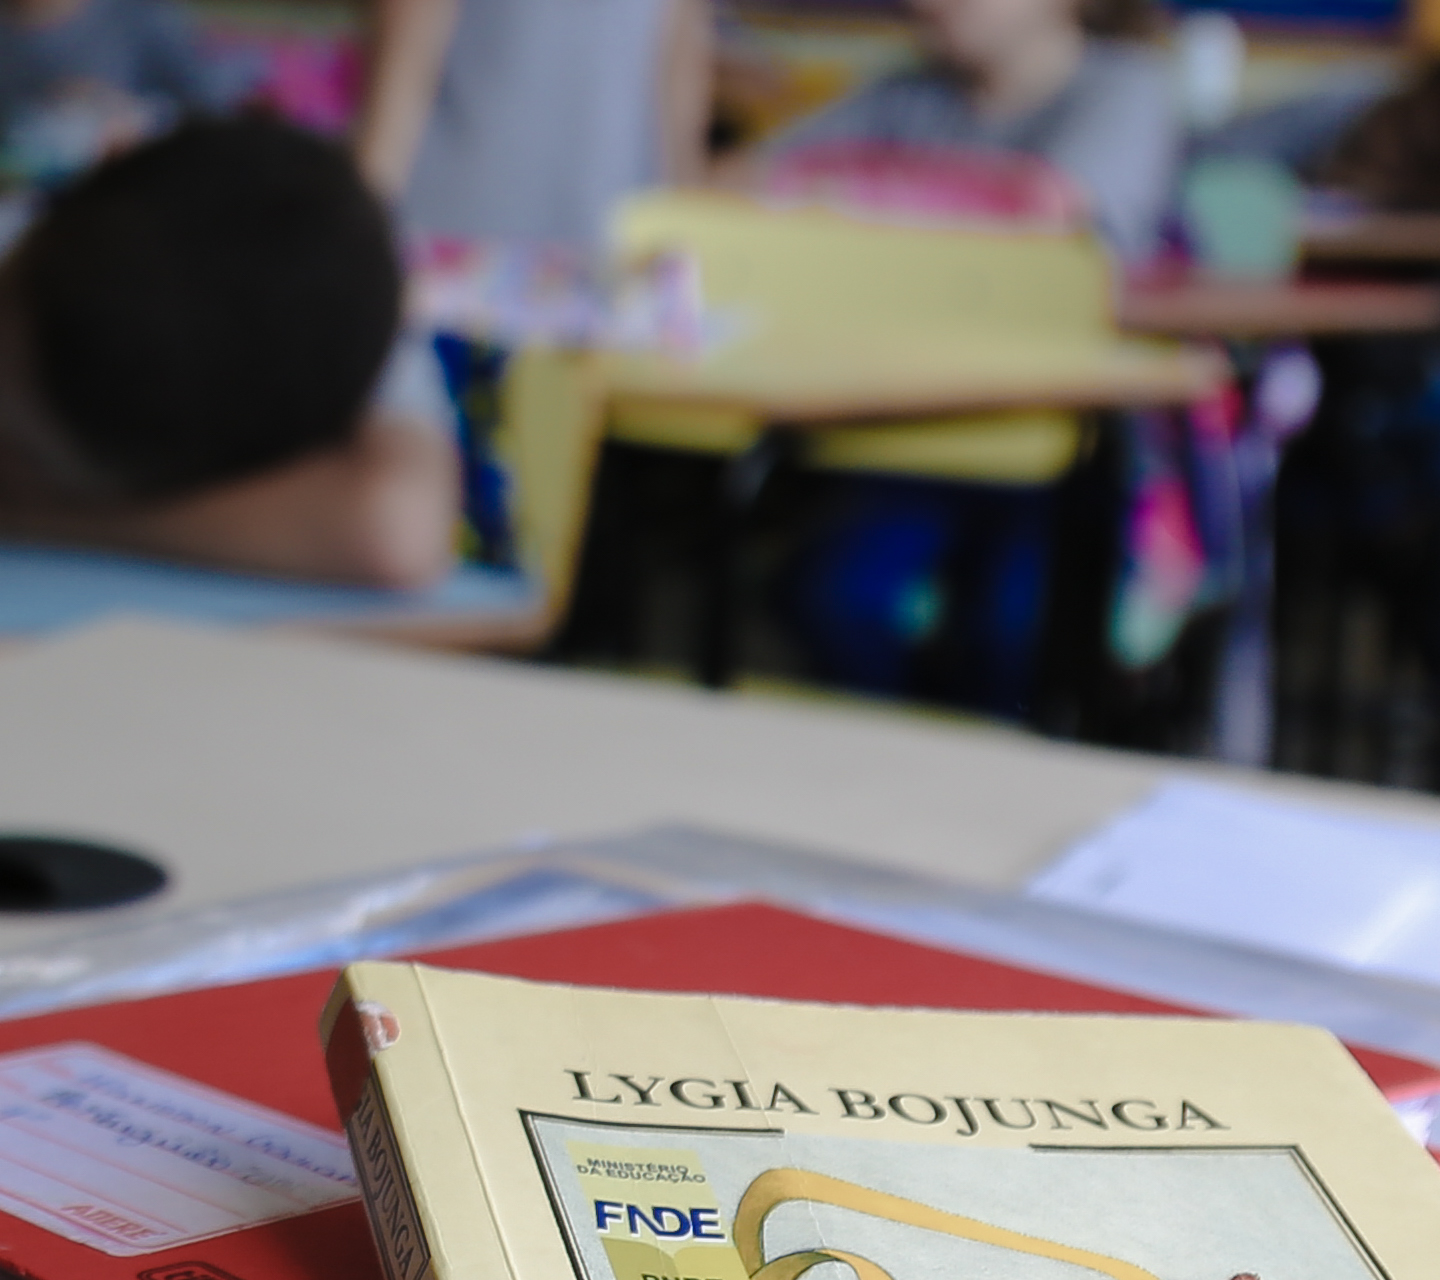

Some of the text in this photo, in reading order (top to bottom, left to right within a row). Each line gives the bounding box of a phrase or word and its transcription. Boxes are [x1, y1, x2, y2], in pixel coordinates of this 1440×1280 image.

[563, 1068, 1231, 1136] LYGIA BOJUNGA
[576, 1164, 706, 1183] DA EDUCAÇÃO
[586, 1158, 689, 1174] MINISTÉRIO
[594, 1199, 726, 1240] FNDE
